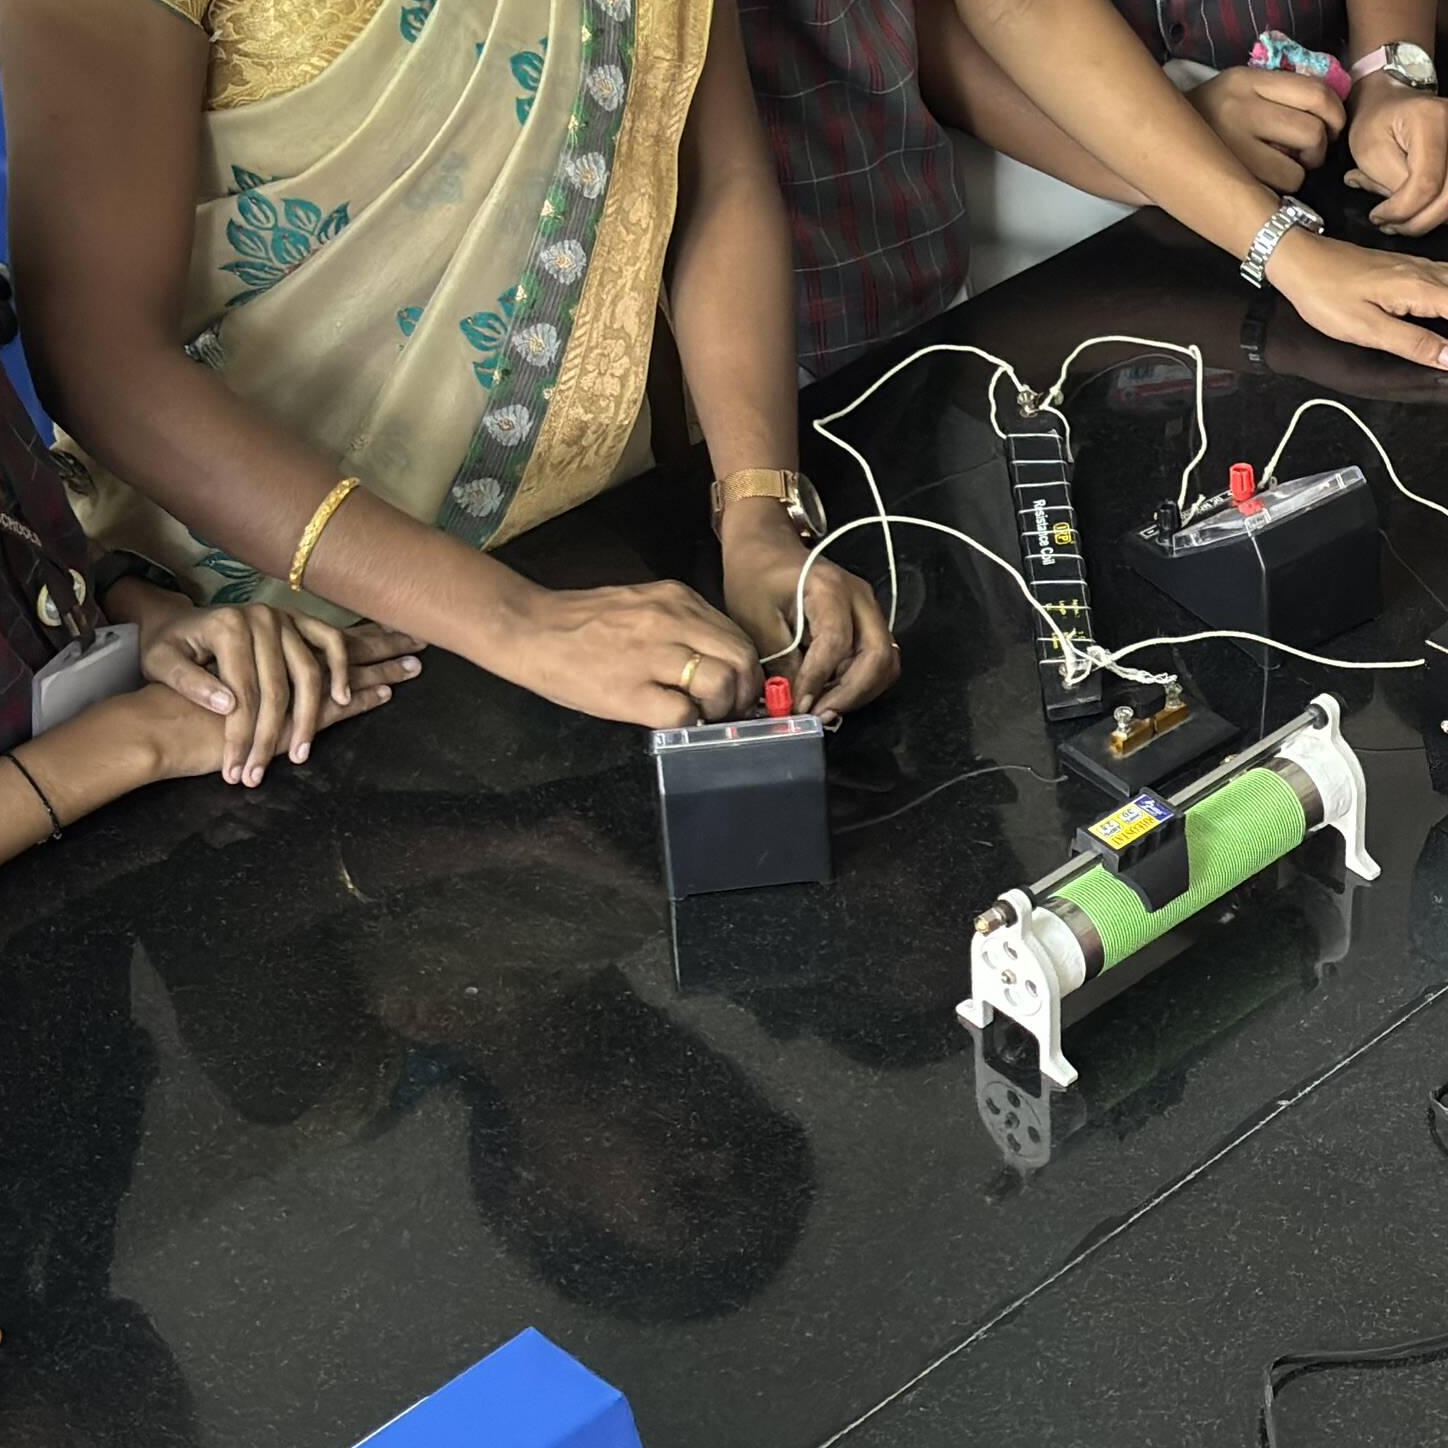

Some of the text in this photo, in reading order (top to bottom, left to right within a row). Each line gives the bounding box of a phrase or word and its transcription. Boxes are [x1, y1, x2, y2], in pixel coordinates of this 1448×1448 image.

[1032, 498, 1056, 565] Resistance Coil
[1111, 815, 1156, 846] RHEOSTAT
